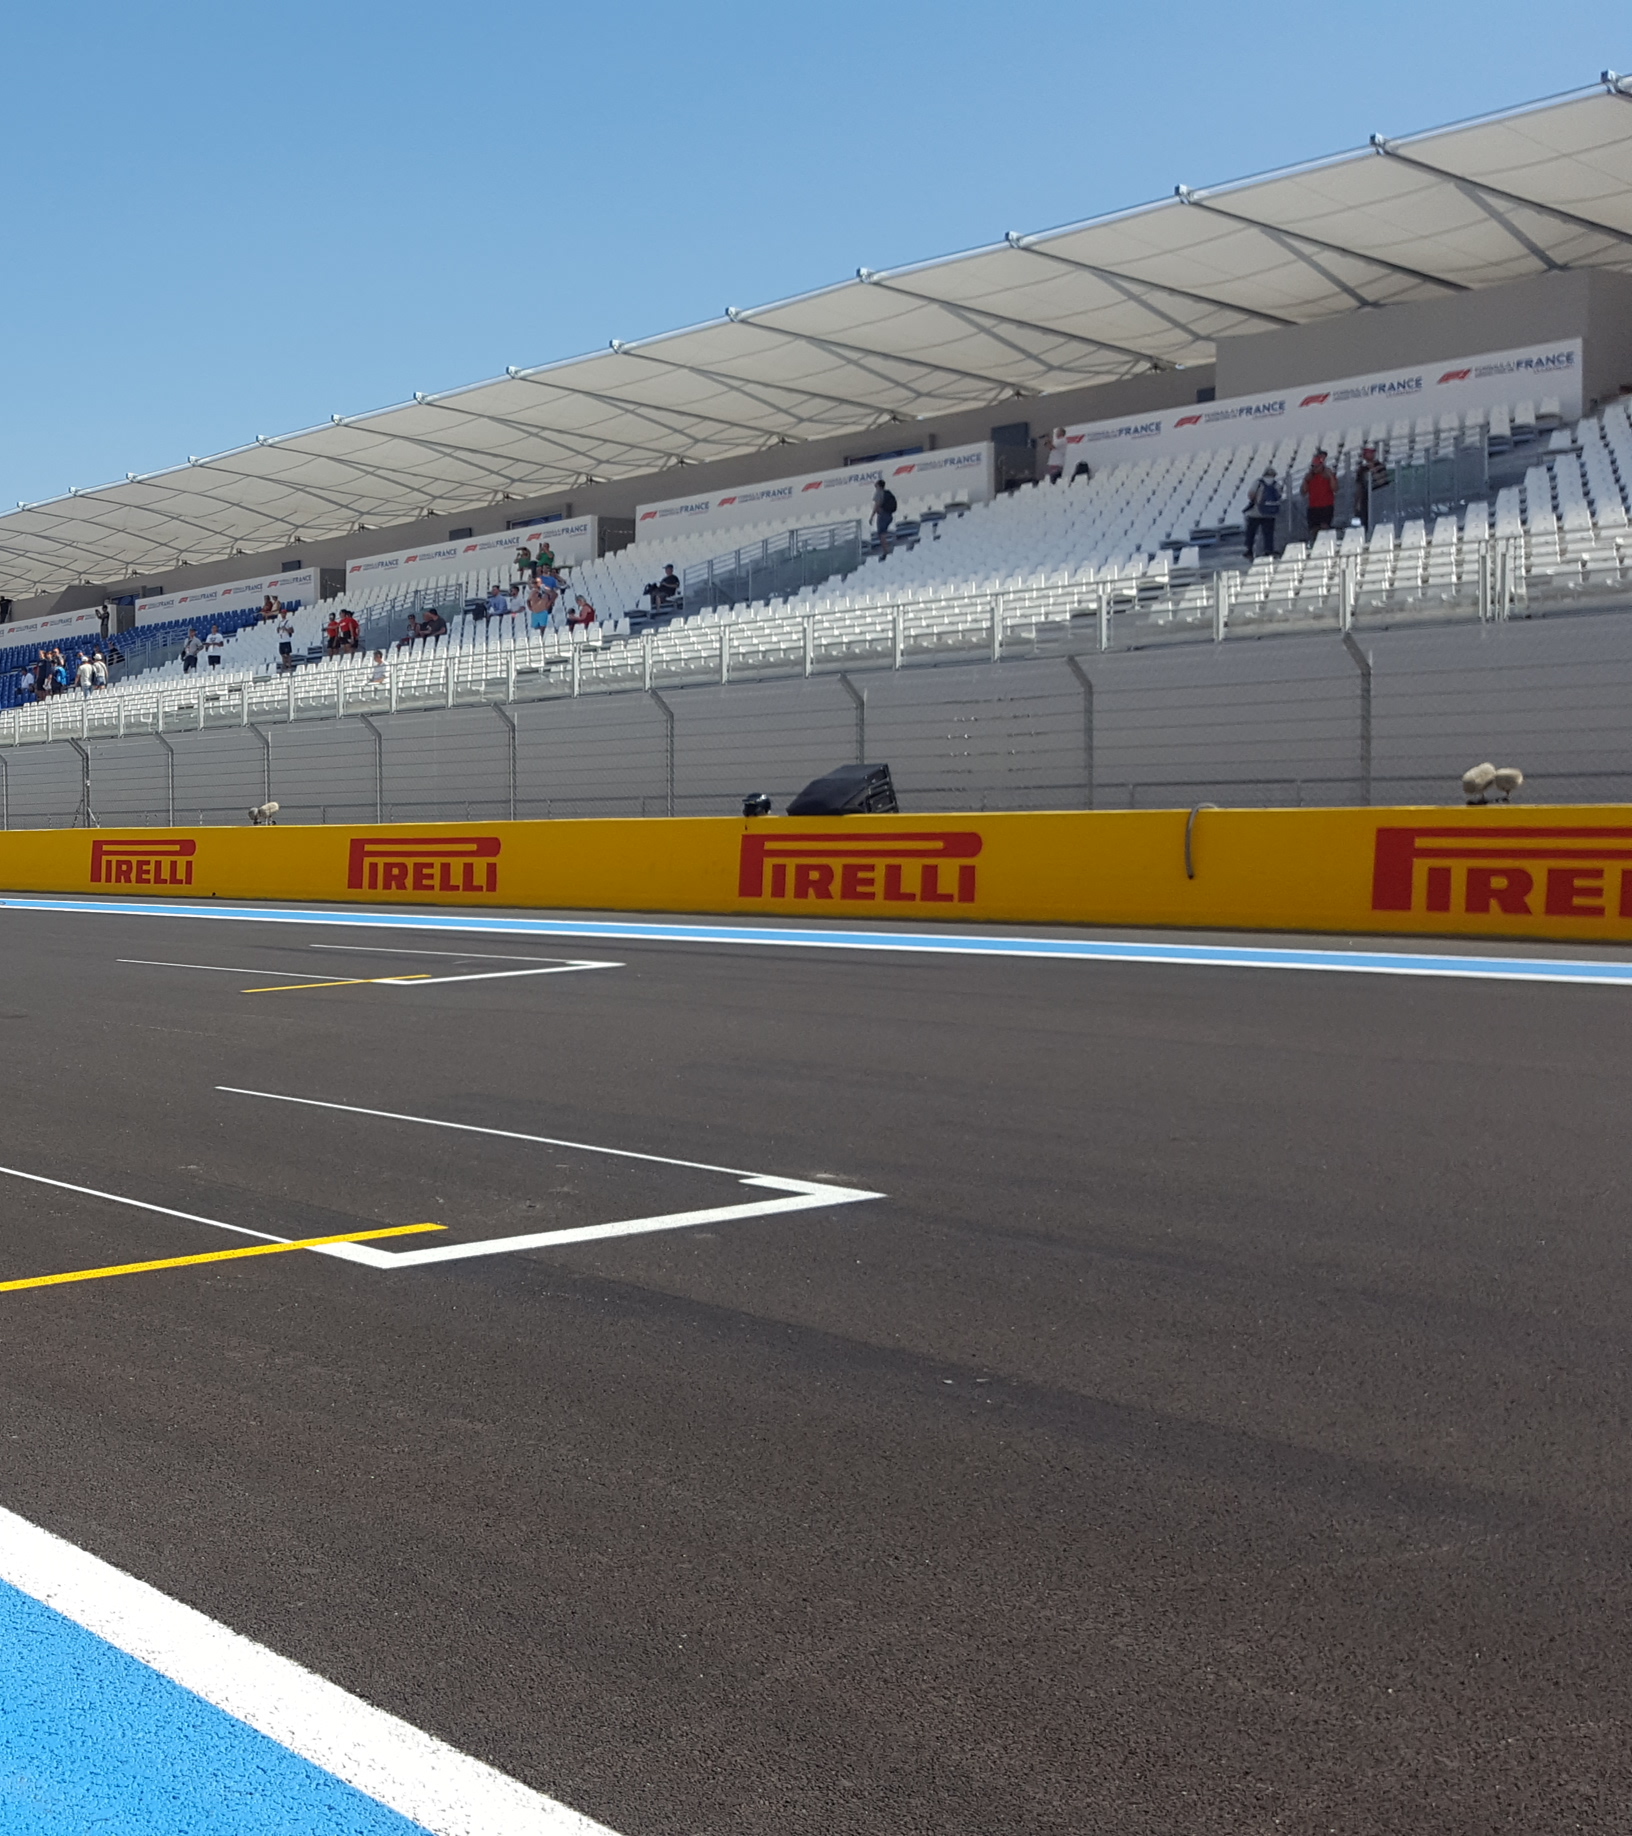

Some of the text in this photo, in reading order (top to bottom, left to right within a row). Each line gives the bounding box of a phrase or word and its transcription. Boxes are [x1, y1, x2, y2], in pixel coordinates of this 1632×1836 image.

[1514, 350, 1575, 372] FRANCE
[1369, 375, 1424, 396] FRANCE
[1237, 400, 1286, 418] FRANCE
[1117, 420, 1162, 438] FRANCE
[942, 451, 982, 468] FRANCE
[760, 486, 794, 500] FRANCE
[679, 501, 710, 515] FRANCE
[90, 839, 197, 886] PIRELLI
[346, 837, 502, 893] PIRELLI
[738, 826, 984, 904] PIRELLI
